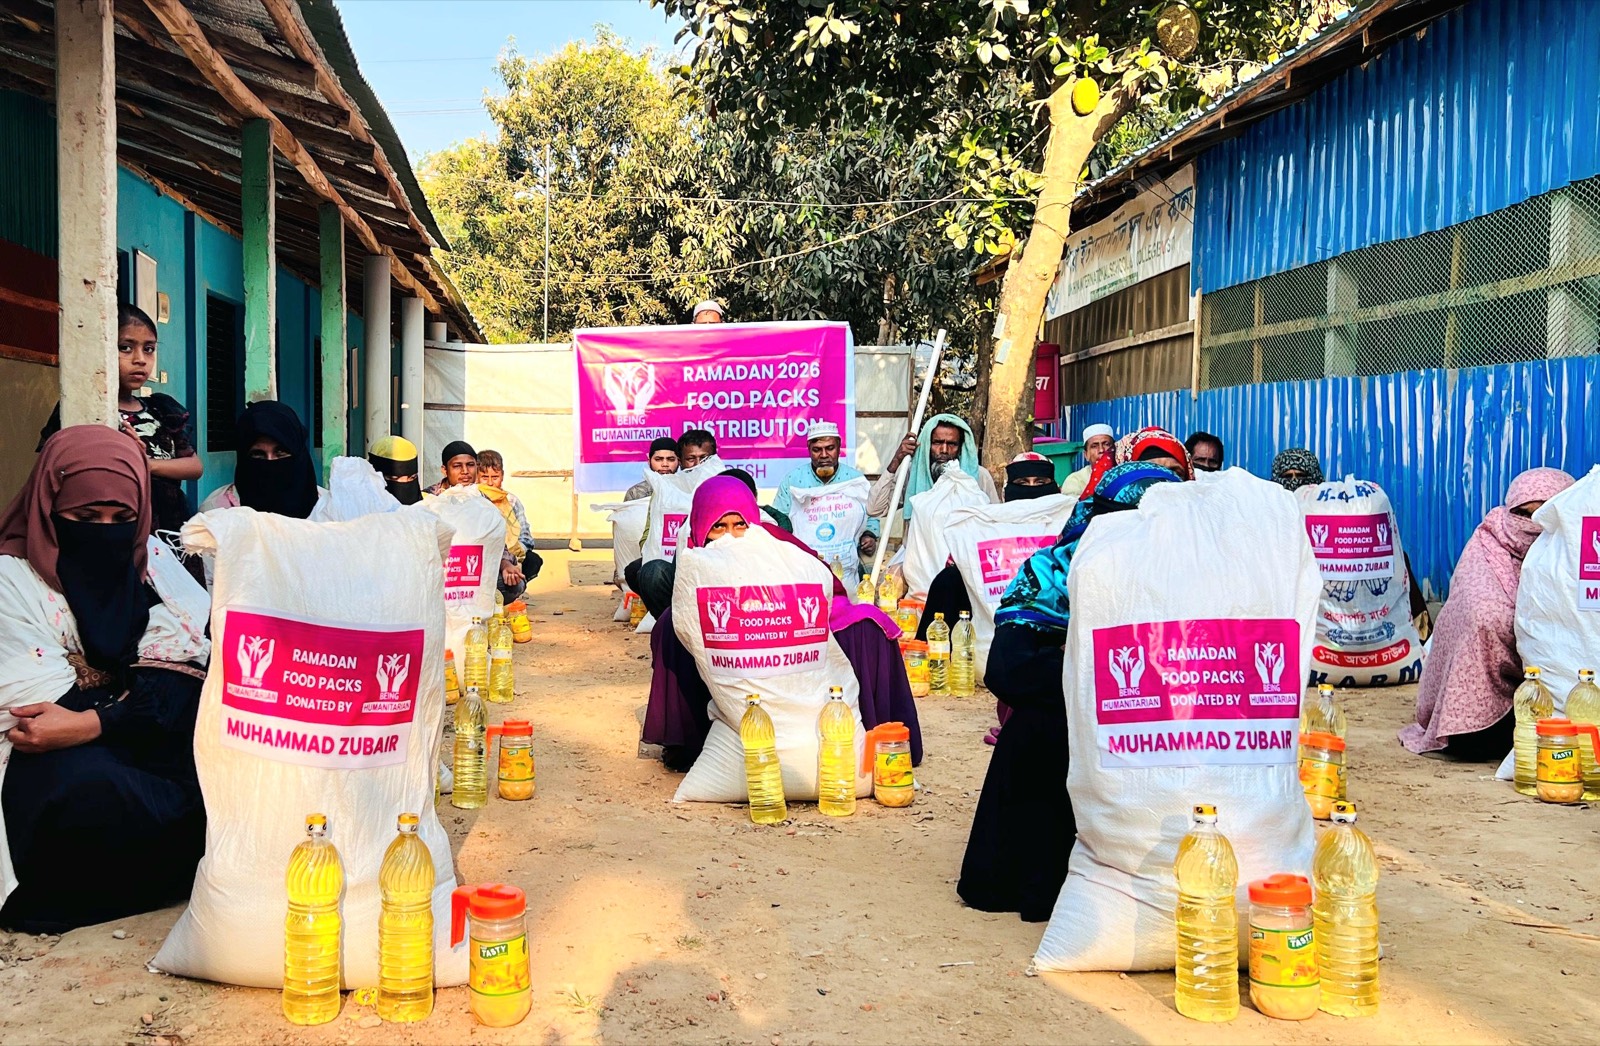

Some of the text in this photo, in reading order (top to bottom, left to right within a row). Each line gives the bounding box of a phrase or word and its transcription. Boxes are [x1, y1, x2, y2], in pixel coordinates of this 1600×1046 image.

[683, 361, 820, 382] RAMADAN 2026
[687, 388, 820, 410] FOOD PACKS
[617, 415, 646, 426] BEING
[594, 428, 669, 441] HUMANITARIAN
[1353, 536, 1373, 544] PACKS
[1365, 561, 1390, 572] ZUBAIR
[741, 601, 787, 613] RAMADAN
[739, 616, 793, 627] FOOD PACKS
[744, 631, 788, 641] DONATED BY
[292, 648, 357, 669] RAMADAN
[711, 650, 819, 669] MUHAMMAD ZUBAIR
[1167, 646, 1237, 661] RAMADAN
[1344, 654, 1378, 665] আতপ
[1381, 643, 1407, 661] চাউল
[283, 670, 362, 693] FOOD PACKS
[1161, 670, 1245, 685] FOOD PACKS
[1119, 687, 1140, 697] BEING
[1263, 683, 1280, 692] BEING
[380, 691, 399, 700] BEING
[1170, 694, 1240, 706] DONATED BY
[1250, 695, 1296, 704] HUMANITARIAN
[286, 694, 353, 713] DONATED BY
[364, 702, 410, 712] HUMANITARIAN
[1103, 698, 1159, 710] HUMANITARIAN
[227, 717, 399, 756] MUHAMMAD ZUBAIR
[1108, 730, 1292, 755] MUHAMMAD ZUBAIR
[1553, 751, 1573, 760] TASTY
[1289, 931, 1313, 948] TASTY
[481, 945, 506, 958] TASTY
